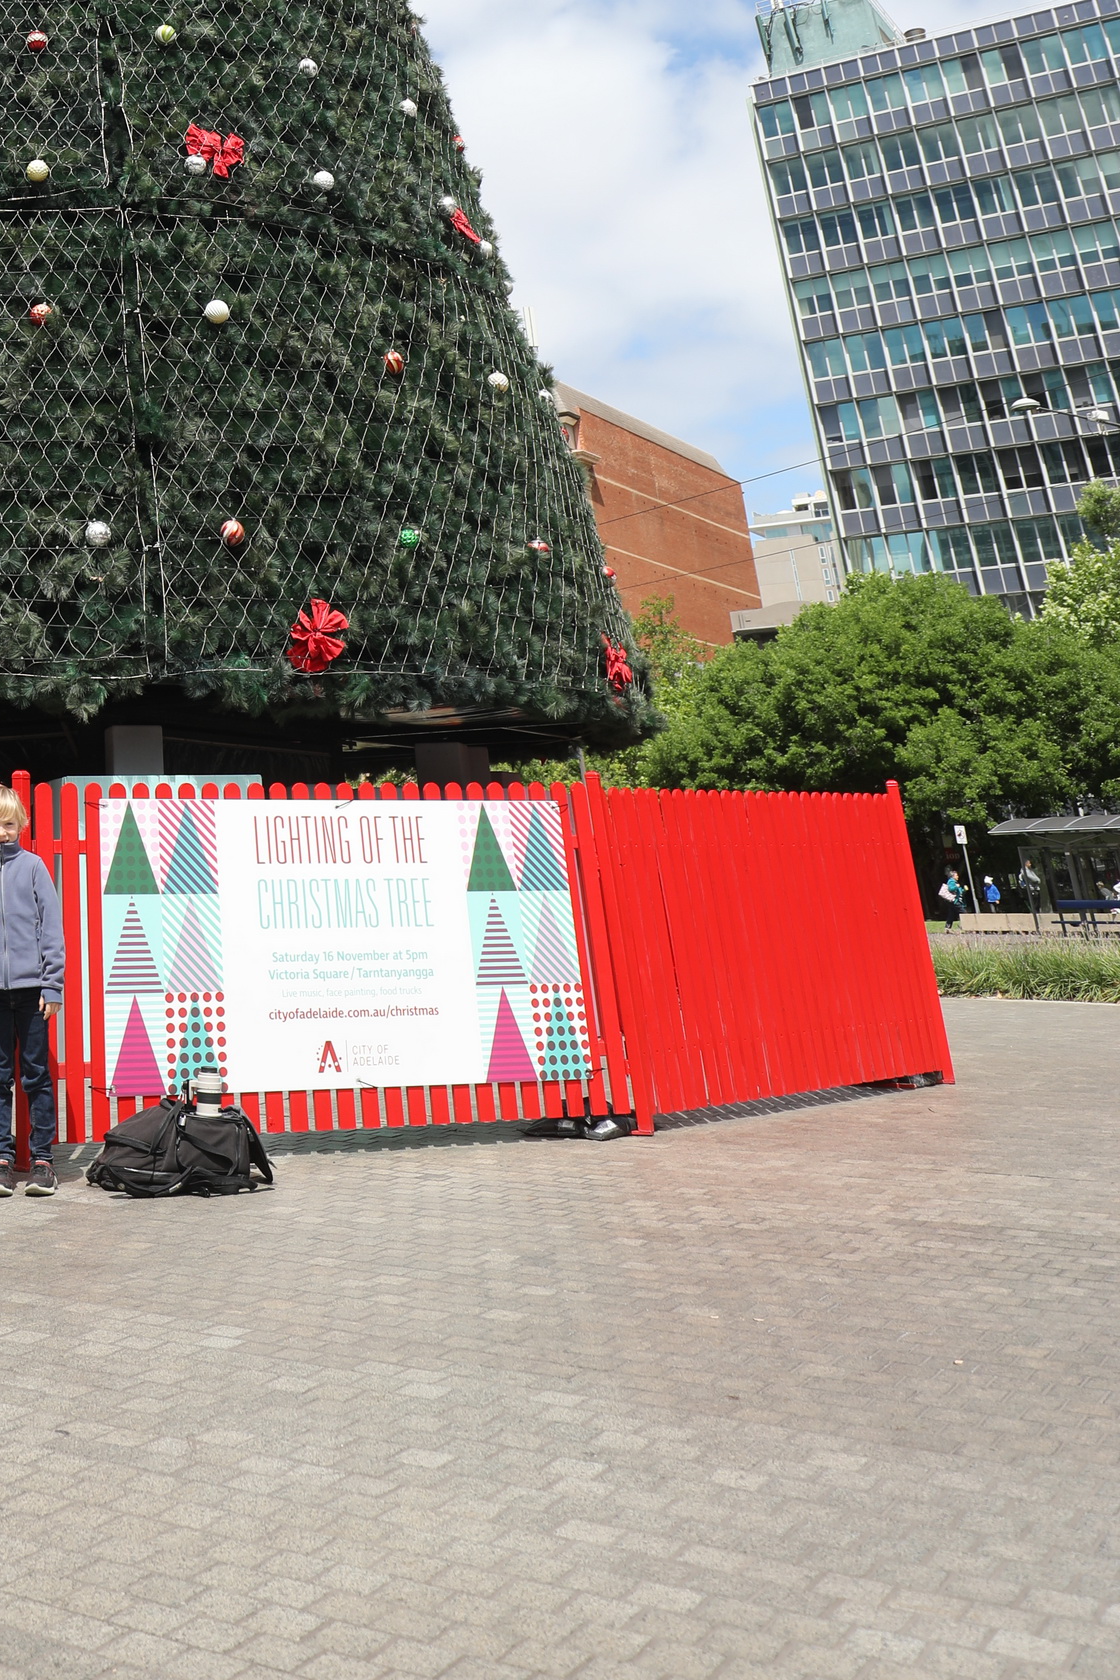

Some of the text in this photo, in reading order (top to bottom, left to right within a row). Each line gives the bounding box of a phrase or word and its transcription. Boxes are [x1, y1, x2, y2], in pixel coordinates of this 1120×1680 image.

[253, 815, 429, 864] LIGHTING OF THE
[257, 877, 435, 930] CHRISTMAS TREE
[271, 949, 429, 966] Saturday 16 November at 5pm
[268, 969, 310, 981] Victoria
[313, 968, 350, 982] Square
[356, 967, 435, 980] Tarntanyangga
[281, 985, 423, 1000] Live music, face painting, food trucks
[268, 1004, 440, 1022] cityofadelaide.com.au/christmas
[352, 1043, 389, 1055] CITY OF
[352, 1055, 400, 1067] ADELAIDE
